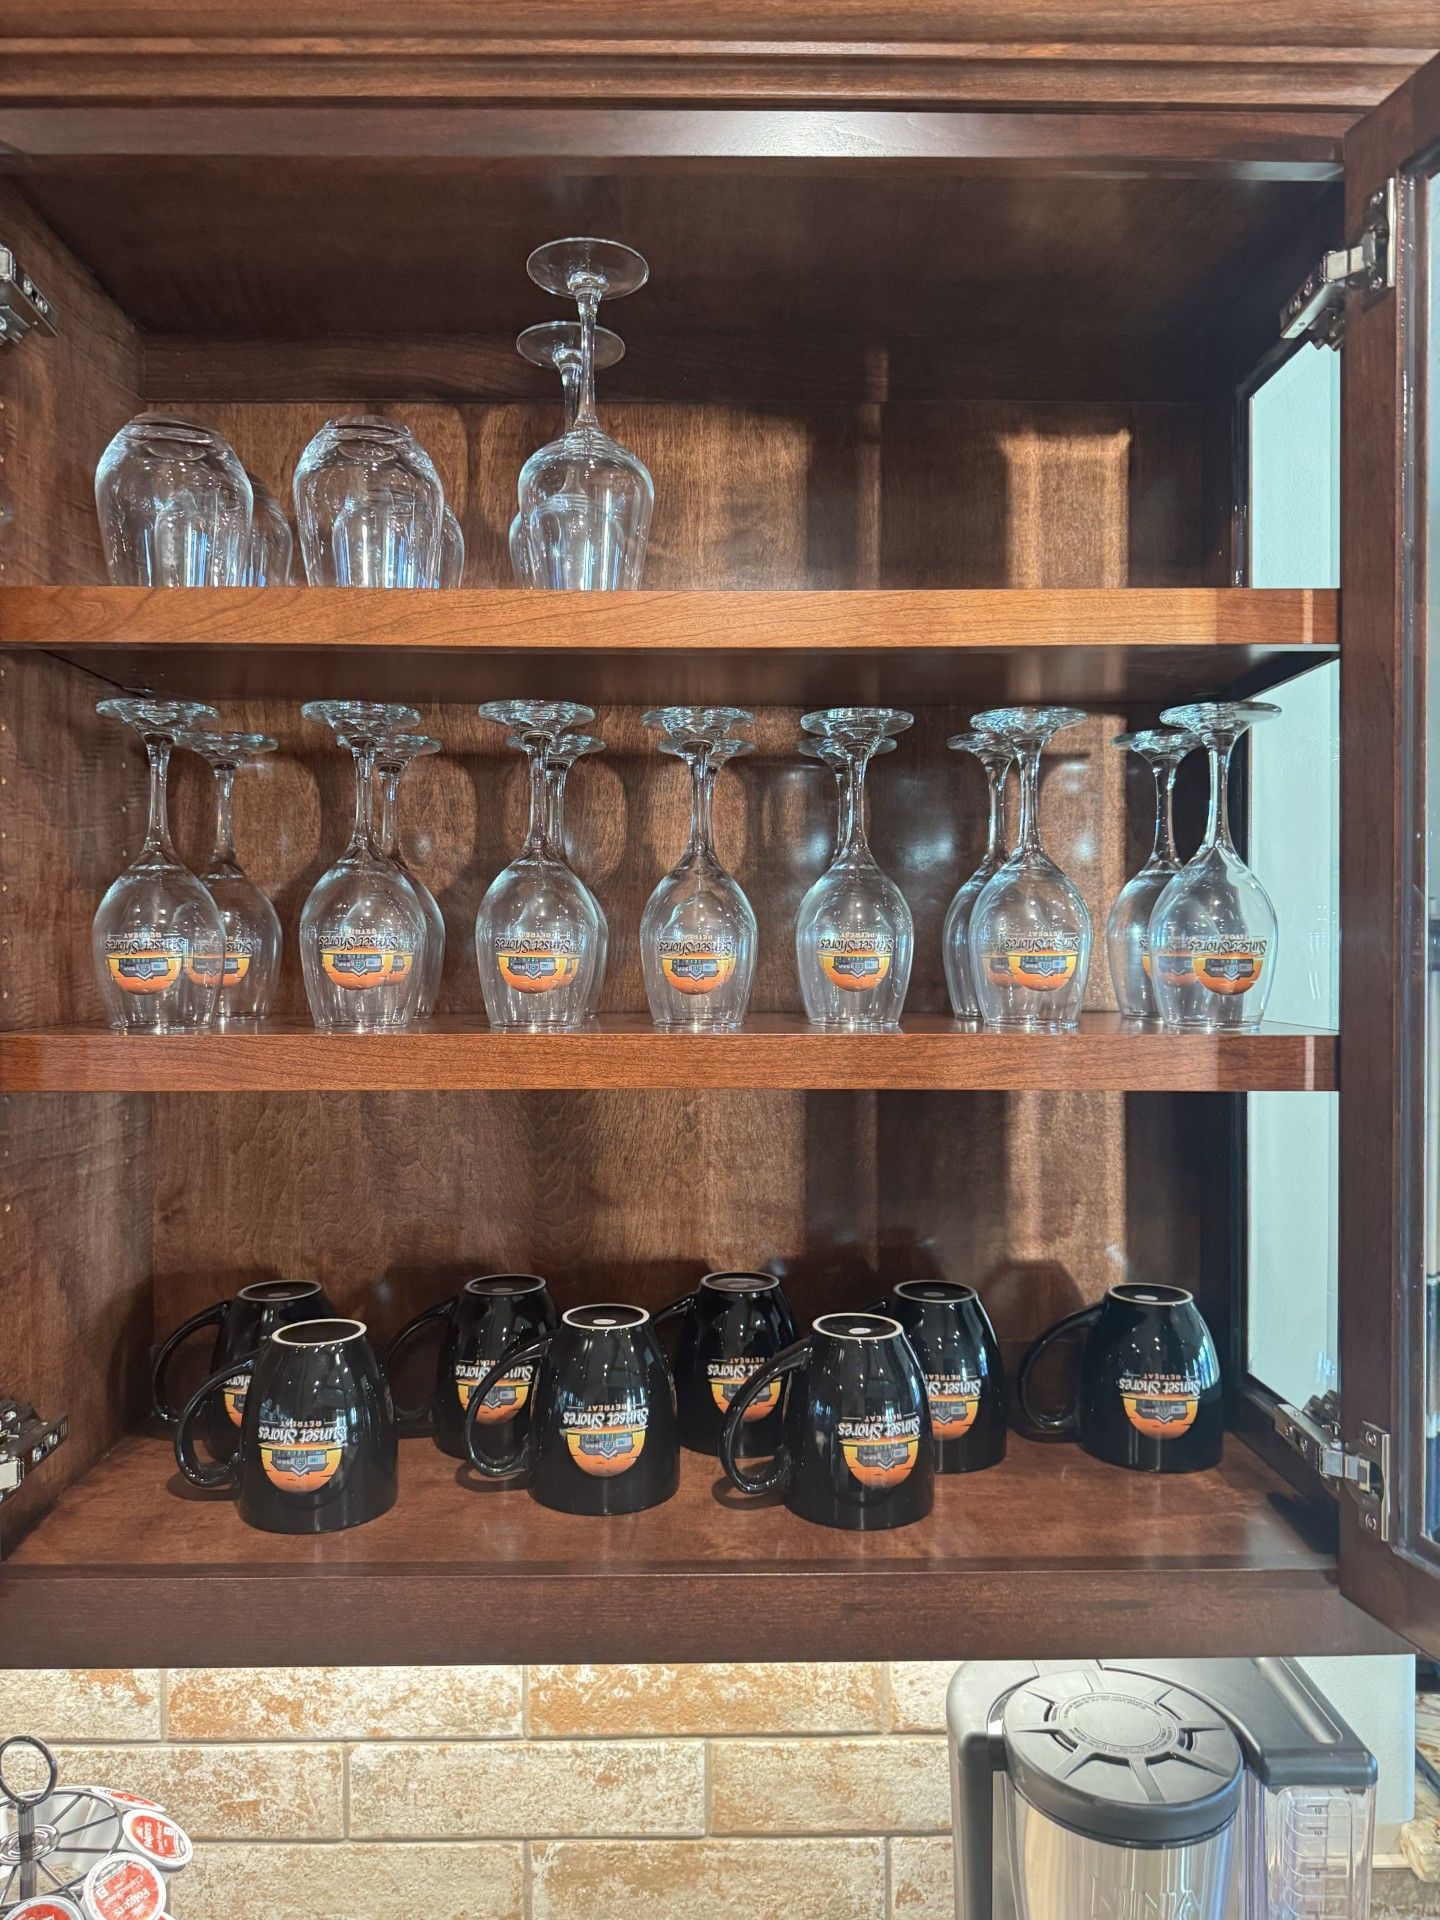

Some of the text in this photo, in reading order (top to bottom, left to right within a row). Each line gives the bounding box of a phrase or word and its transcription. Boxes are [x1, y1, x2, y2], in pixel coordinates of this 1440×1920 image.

[105, 938, 140, 954] Shores
[319, 935, 356, 950] Shores
[495, 937, 571, 953] Sunset Shores
[659, 940, 693, 956] Shores
[820, 939, 856, 954] Shores
[1005, 937, 1043, 953] Shores
[1188, 940, 1268, 955] Sunset Shores
[504, 1364, 534, 1381] Suns
[707, 1363, 746, 1380] Shores
[1143, 1373, 1182, 1381] RETREAT
[943, 1379, 982, 1397] Sunset
[1118, 1377, 1201, 1397] Sunset Shores
[586, 1403, 628, 1412] RETREAT
[280, 1420, 322, 1428] RETREAT
[562, 1407, 650, 1430] Sunset Shores
[258, 1425, 348, 1447] Sunset Shores
[837, 1415, 921, 1441] Sunset Shores
